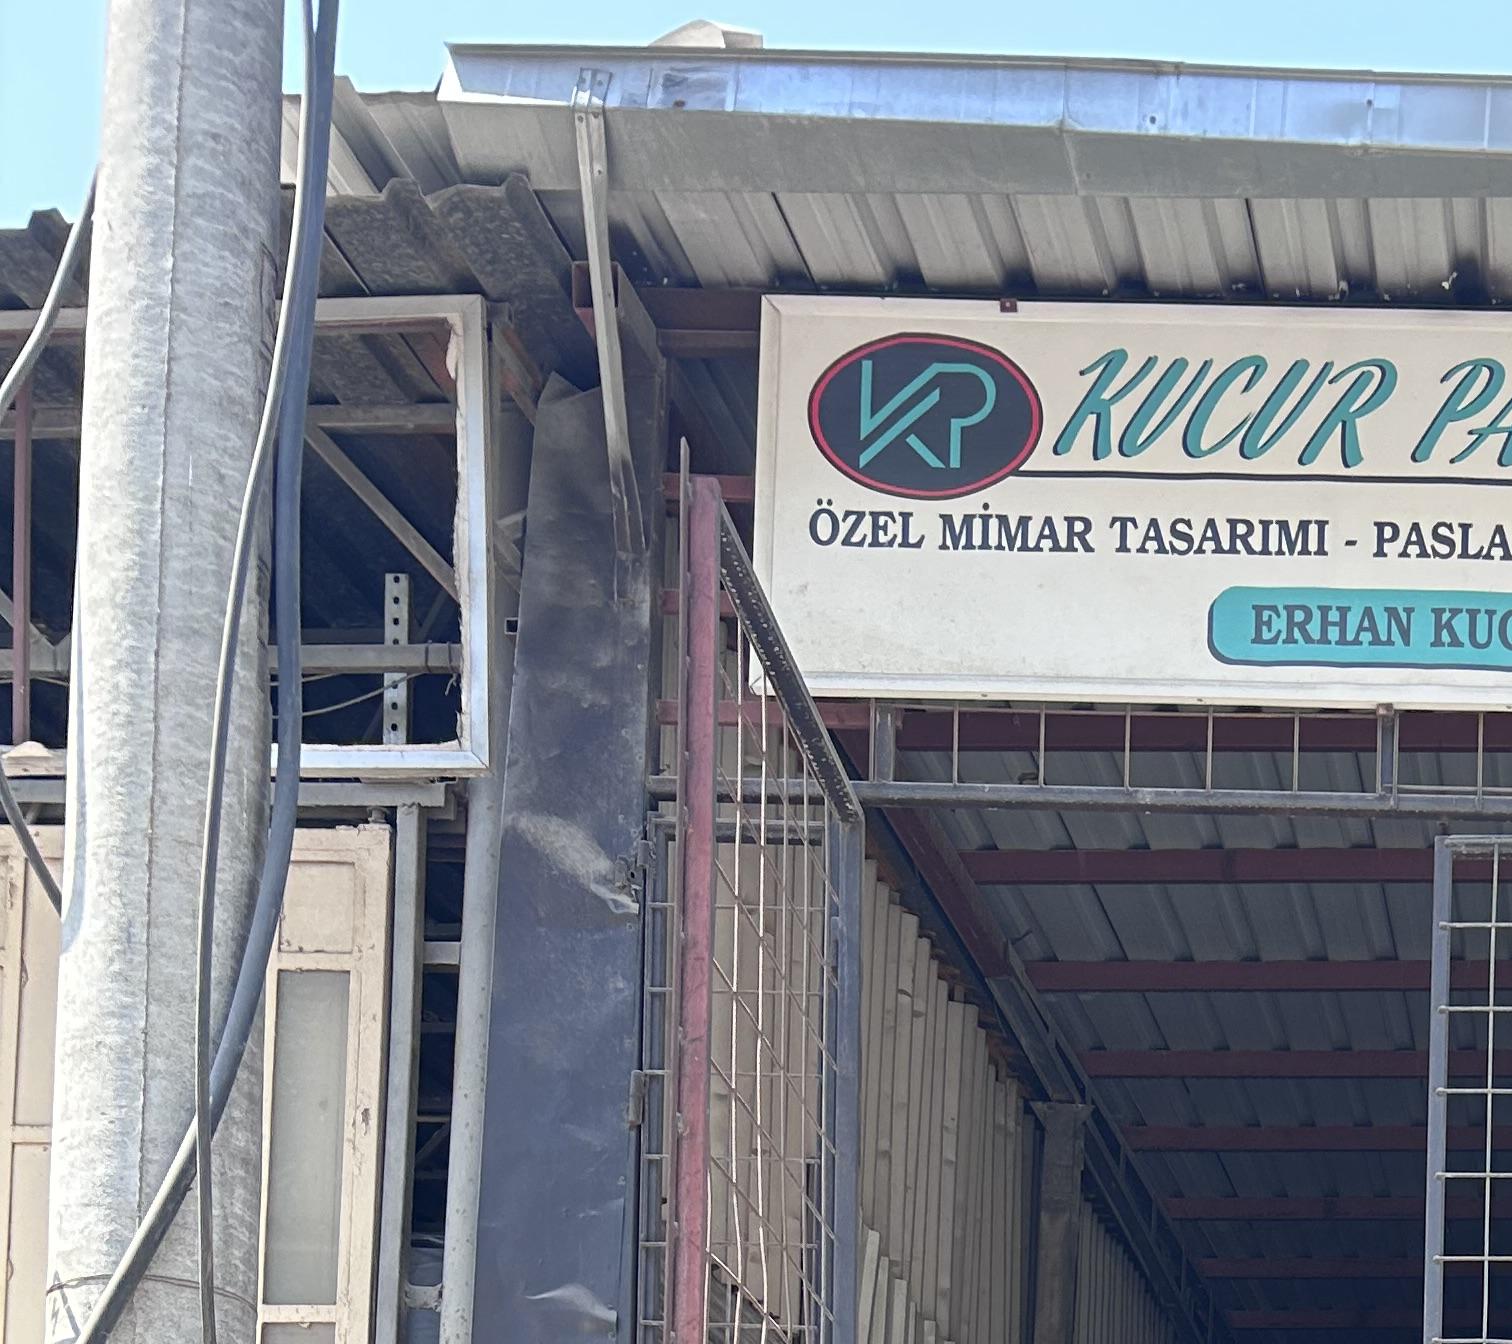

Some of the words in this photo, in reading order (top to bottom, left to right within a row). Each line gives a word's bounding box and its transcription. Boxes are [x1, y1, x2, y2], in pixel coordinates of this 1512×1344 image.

[1052, 348, 1398, 469] KUCUR
[808, 497, 925, 549] ÖZEL
[938, 502, 1096, 554] MİMAR
[1109, 516, 1330, 558] TASARIMI
[1250, 603, 1415, 649] ERHAN
